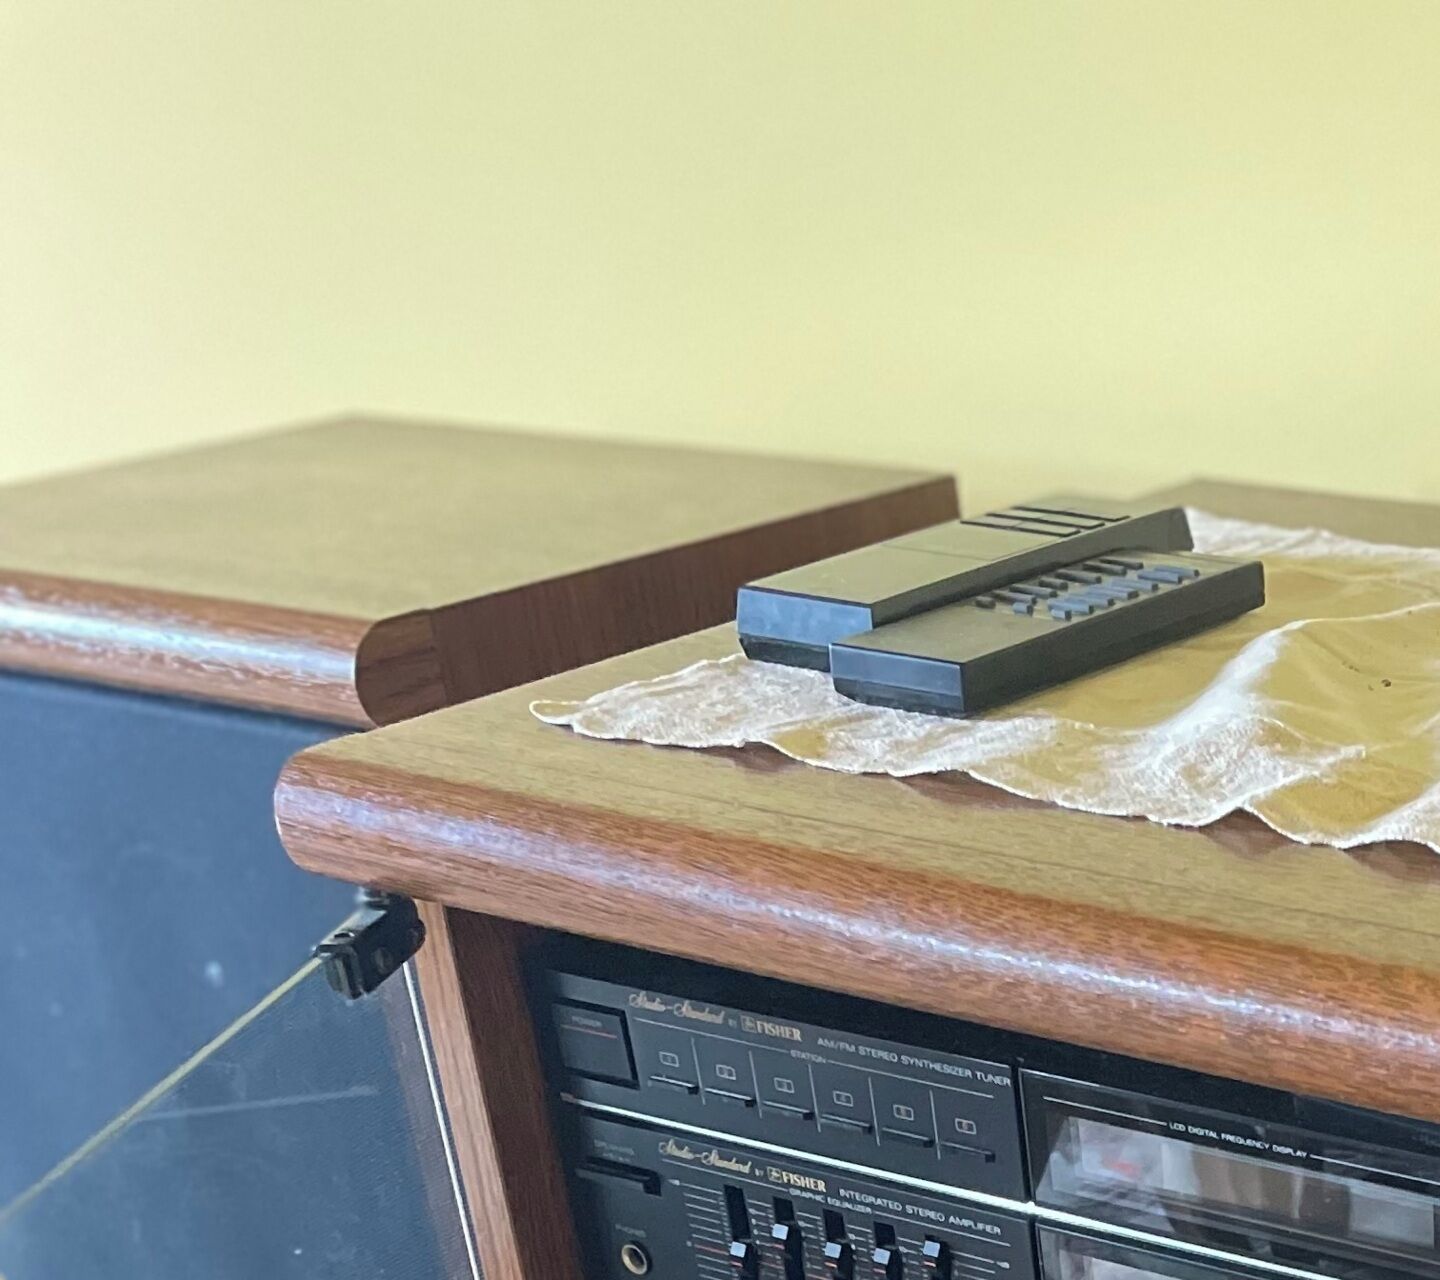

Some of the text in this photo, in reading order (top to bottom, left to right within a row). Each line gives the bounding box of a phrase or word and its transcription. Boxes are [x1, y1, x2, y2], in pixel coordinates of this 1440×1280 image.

[756, 1020, 803, 1043] FISHER
[817, 1036, 856, 1054] AM/FM
[858, 1045, 899, 1064] STEREO
[900, 1054, 973, 1079] SYNTHESIZER
[975, 1070, 1012, 1088] TUNER
[790, 1050, 827, 1065] STATION
[1169, 1120, 1308, 1159] LCD DIGITAL FREQUENCY DISPLAY
[782, 1170, 827, 1193] FISHER
[838, 1188, 903, 1212] INTEGRATED
[905, 1203, 946, 1223] STEREO
[948, 1214, 1002, 1236] AMPLIFIER
[788, 1187, 873, 1215] GRAPHIC EQUALIZER
